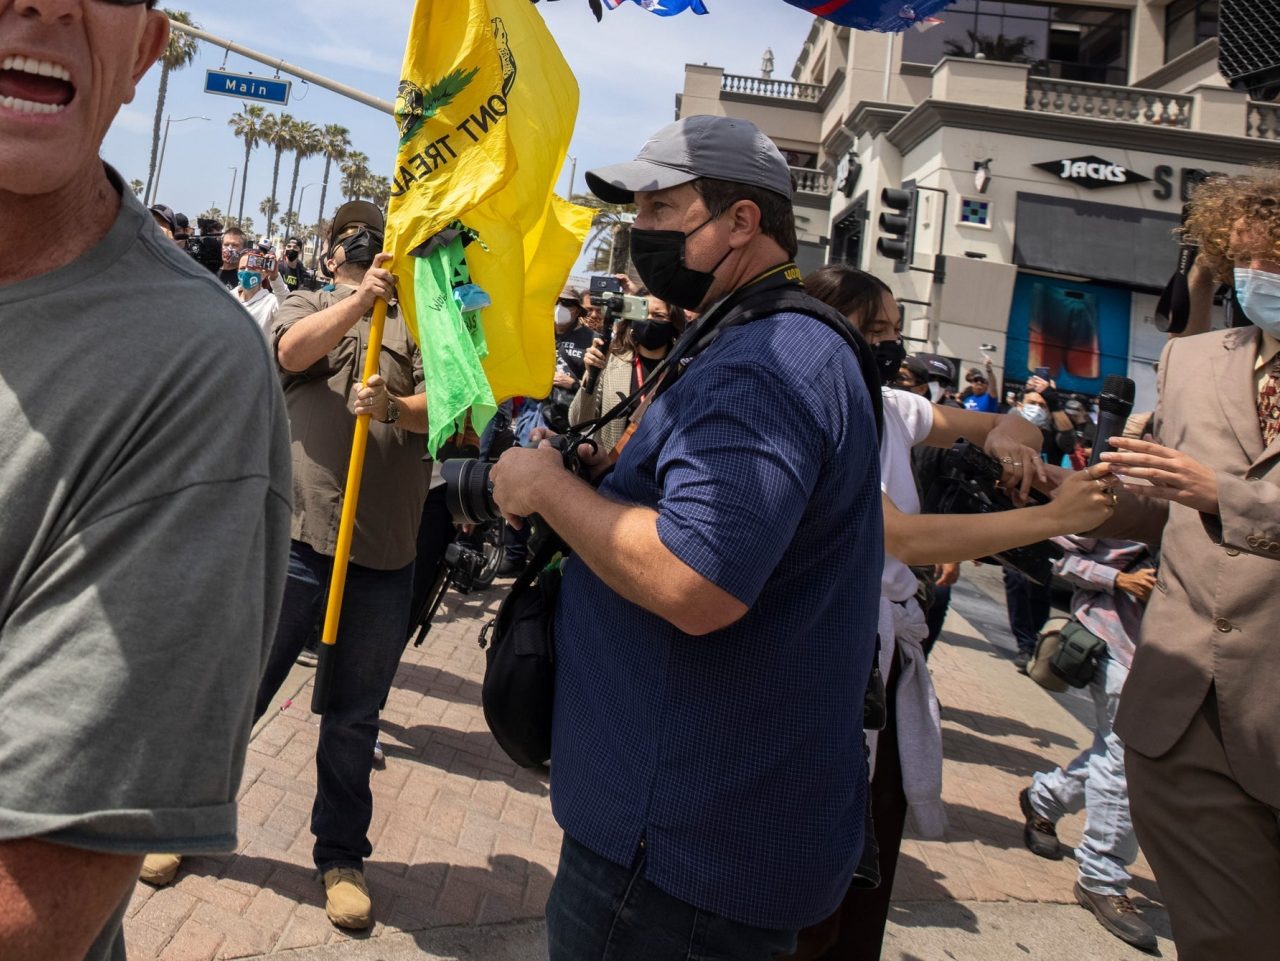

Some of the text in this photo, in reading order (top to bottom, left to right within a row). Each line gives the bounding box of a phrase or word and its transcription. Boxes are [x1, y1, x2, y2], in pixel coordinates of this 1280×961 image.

[225, 79, 267, 96] Main
[1060, 160, 1127, 183] JACK'S
[1180, 249, 1189, 275] SONY
